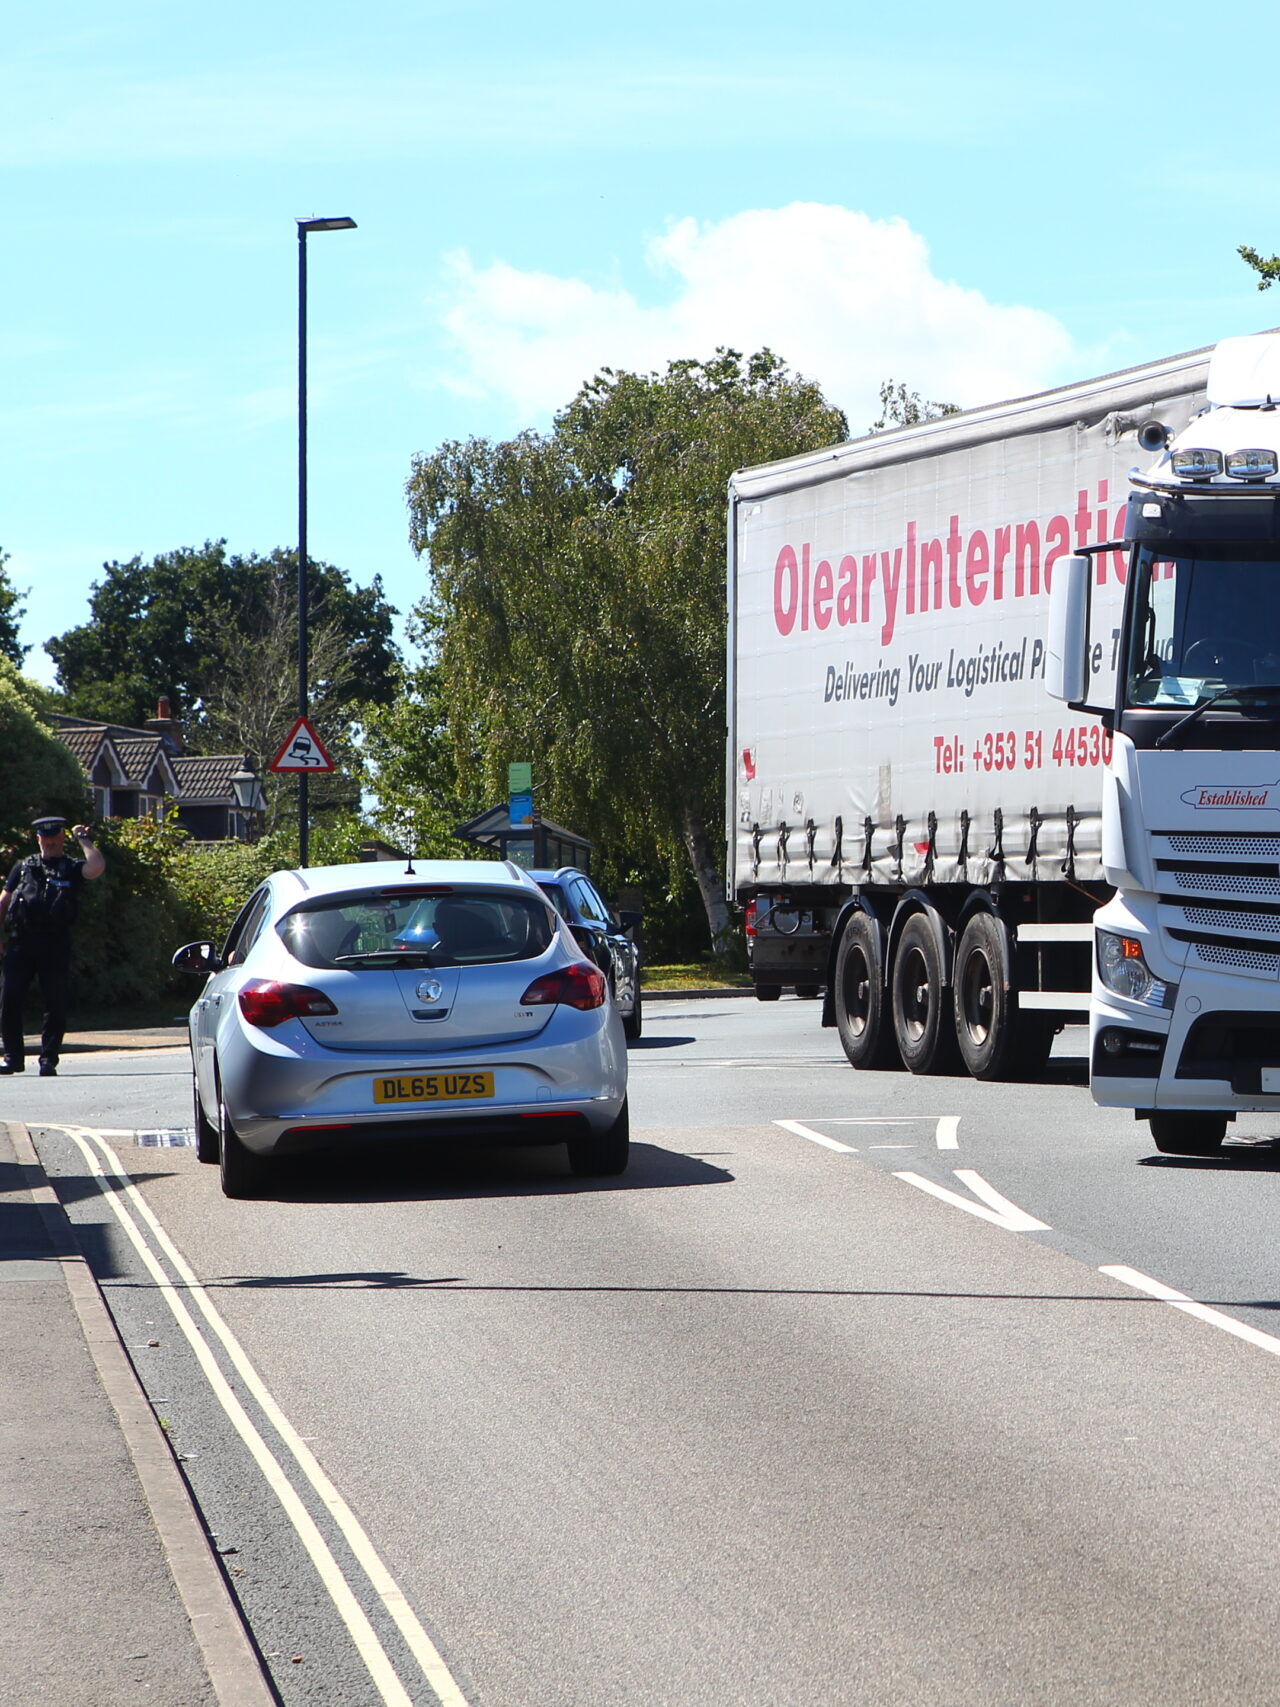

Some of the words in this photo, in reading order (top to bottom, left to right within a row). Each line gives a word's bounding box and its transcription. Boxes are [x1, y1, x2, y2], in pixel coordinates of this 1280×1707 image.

[824, 659, 901, 707] Delivering
[907, 653, 943, 693] Your
[946, 637, 1027, 698] Logistical
[933, 735, 964, 774] Tel:
[973, 730, 1016, 772] +353
[1024, 730, 1042, 770] 51
[1197, 790, 1268, 807] Established
[383, 1077, 439, 1099] DL65
[444, 1074, 486, 1095] UZS
